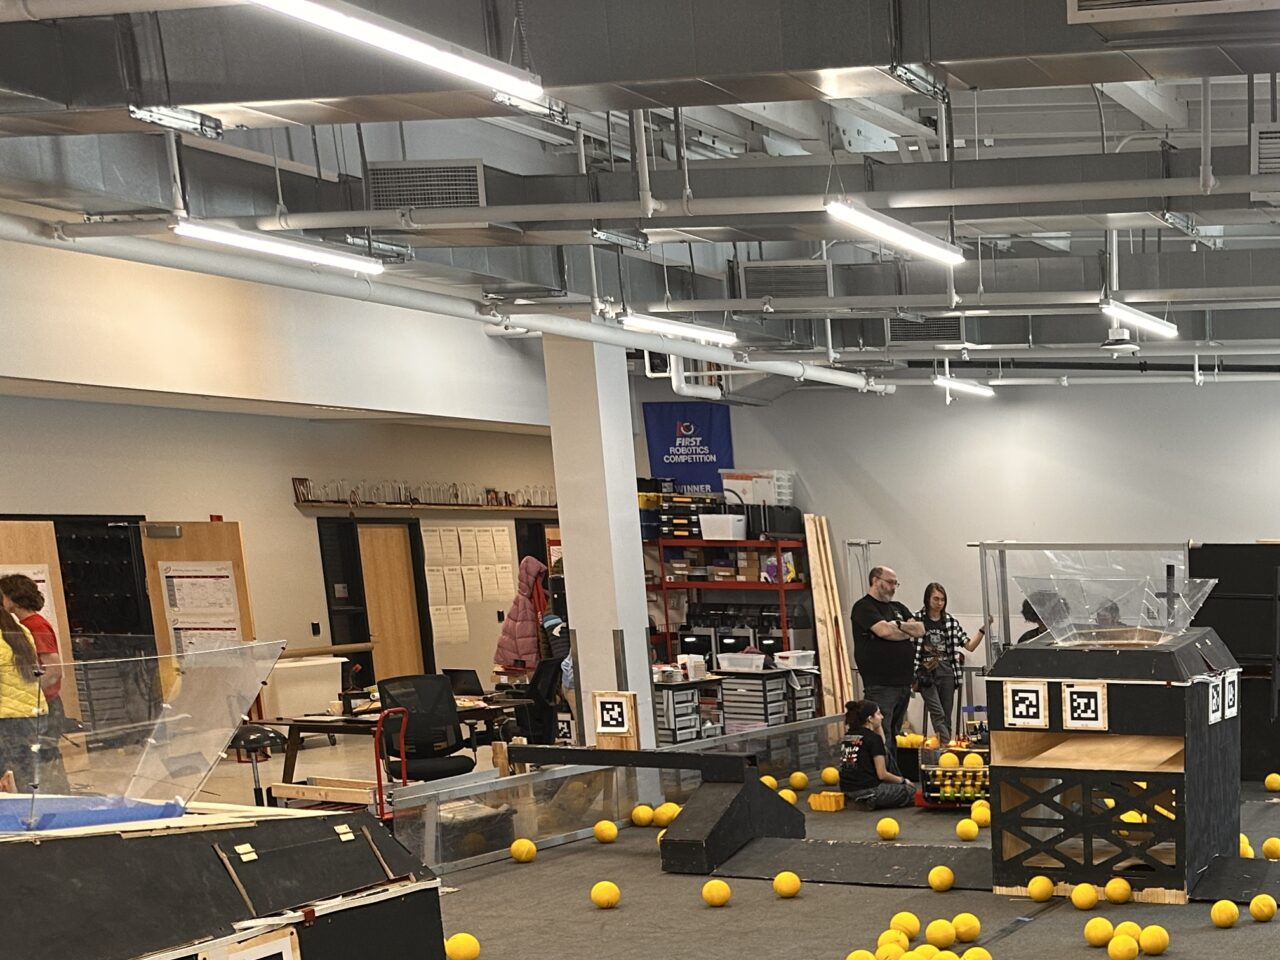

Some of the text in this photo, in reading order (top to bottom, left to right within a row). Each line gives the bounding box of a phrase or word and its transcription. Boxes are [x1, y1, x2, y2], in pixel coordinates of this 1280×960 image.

[675, 437, 702, 446] FIRST
[669, 446, 710, 455] ROBOTICS
[663, 454, 717, 463] COMPETITION
